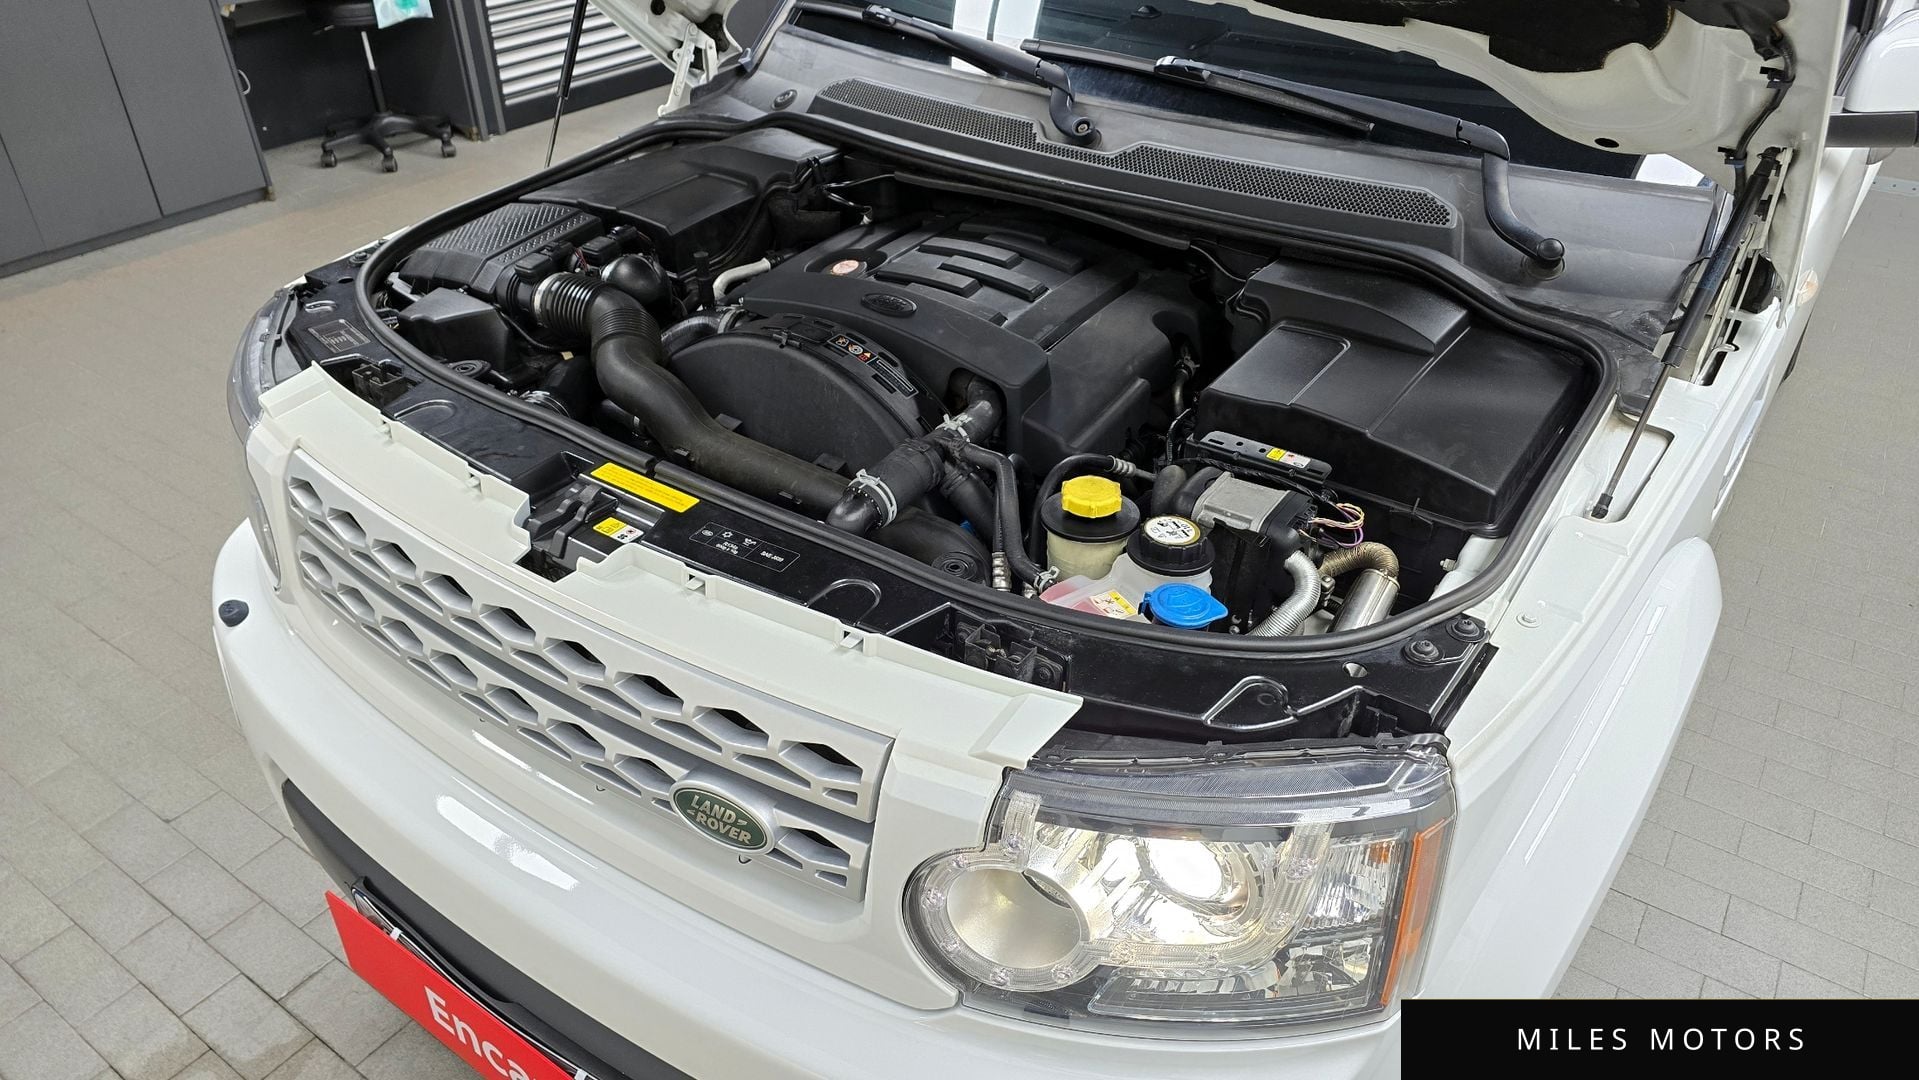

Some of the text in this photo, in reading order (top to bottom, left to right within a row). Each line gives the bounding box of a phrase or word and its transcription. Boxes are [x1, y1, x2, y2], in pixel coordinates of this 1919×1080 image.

[691, 795, 737, 824] LAND
[696, 811, 752, 845] ROVER
[424, 985, 536, 1080] Enca
